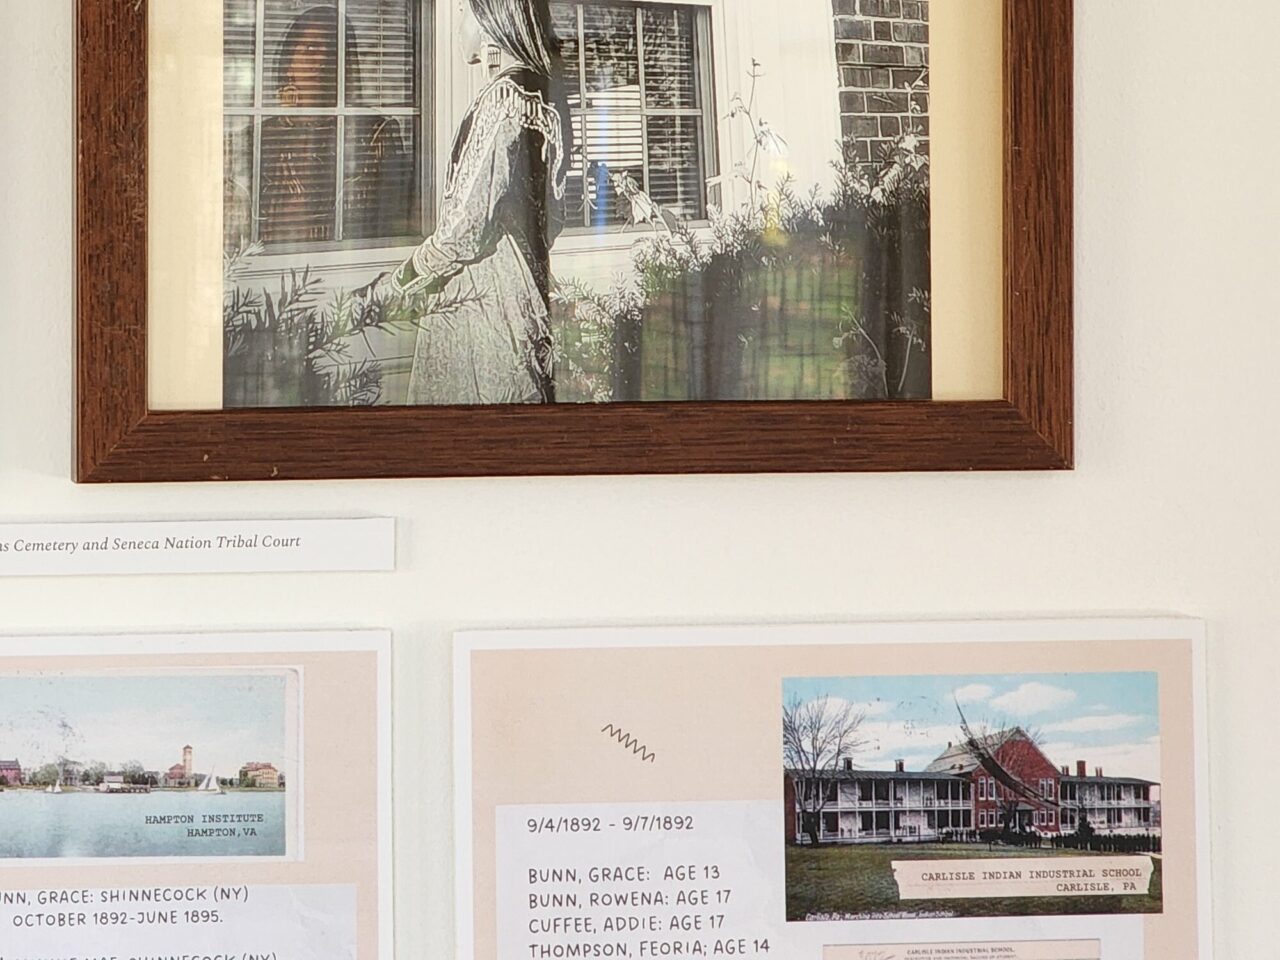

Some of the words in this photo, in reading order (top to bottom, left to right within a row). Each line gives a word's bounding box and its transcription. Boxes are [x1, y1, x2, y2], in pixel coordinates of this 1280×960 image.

[13, 539, 79, 555] Cemetery
[82, 536, 109, 551] and
[111, 537, 160, 551] Seneca
[164, 536, 212, 550] Nation
[216, 534, 258, 549] Tribal
[261, 535, 300, 548] Court
[146, 815, 194, 824] HAMPTON
[202, 814, 263, 823] INSTITUTE
[527, 816, 601, 834] 9/4/1892
[622, 815, 694, 832] 9/7/1892
[528, 868, 583, 886] BUNN,
[588, 866, 650, 883] GRACE:
[663, 864, 696, 881] AGE
[703, 865, 720, 880] 13
[922, 872, 975, 881] CARLISLE
[983, 871, 1021, 879] INDIAN
[1030, 870, 1095, 878] INDUSTRIAL
[1102, 869, 1141, 877] SCHOOL
[37, 889, 94, 905] GRACE:
[100, 887, 207, 903] SHINNECOCK
[213, 885, 249, 903] (NY)
[1057, 883, 1113, 892] CARLISLE,
[1123, 882, 1136, 890] PA
[528, 893, 583, 911] BUNN,
[589, 890, 669, 907] ROWENA:
[676, 889, 709, 906] AGE
[716, 889, 732, 904] 17
[12, 912, 86, 927] OCTOBER
[184, 909, 223, 924] 1895.
[528, 916, 598, 935] CUFFEE,
[603, 915, 662, 932] ADDIE:
[669, 914, 702, 931] AGE
[709, 914, 725, 929] 17
[528, 942, 633, 960] THOMPSON,
[713, 938, 746, 955] AGE
[753, 938, 770, 953] 14
